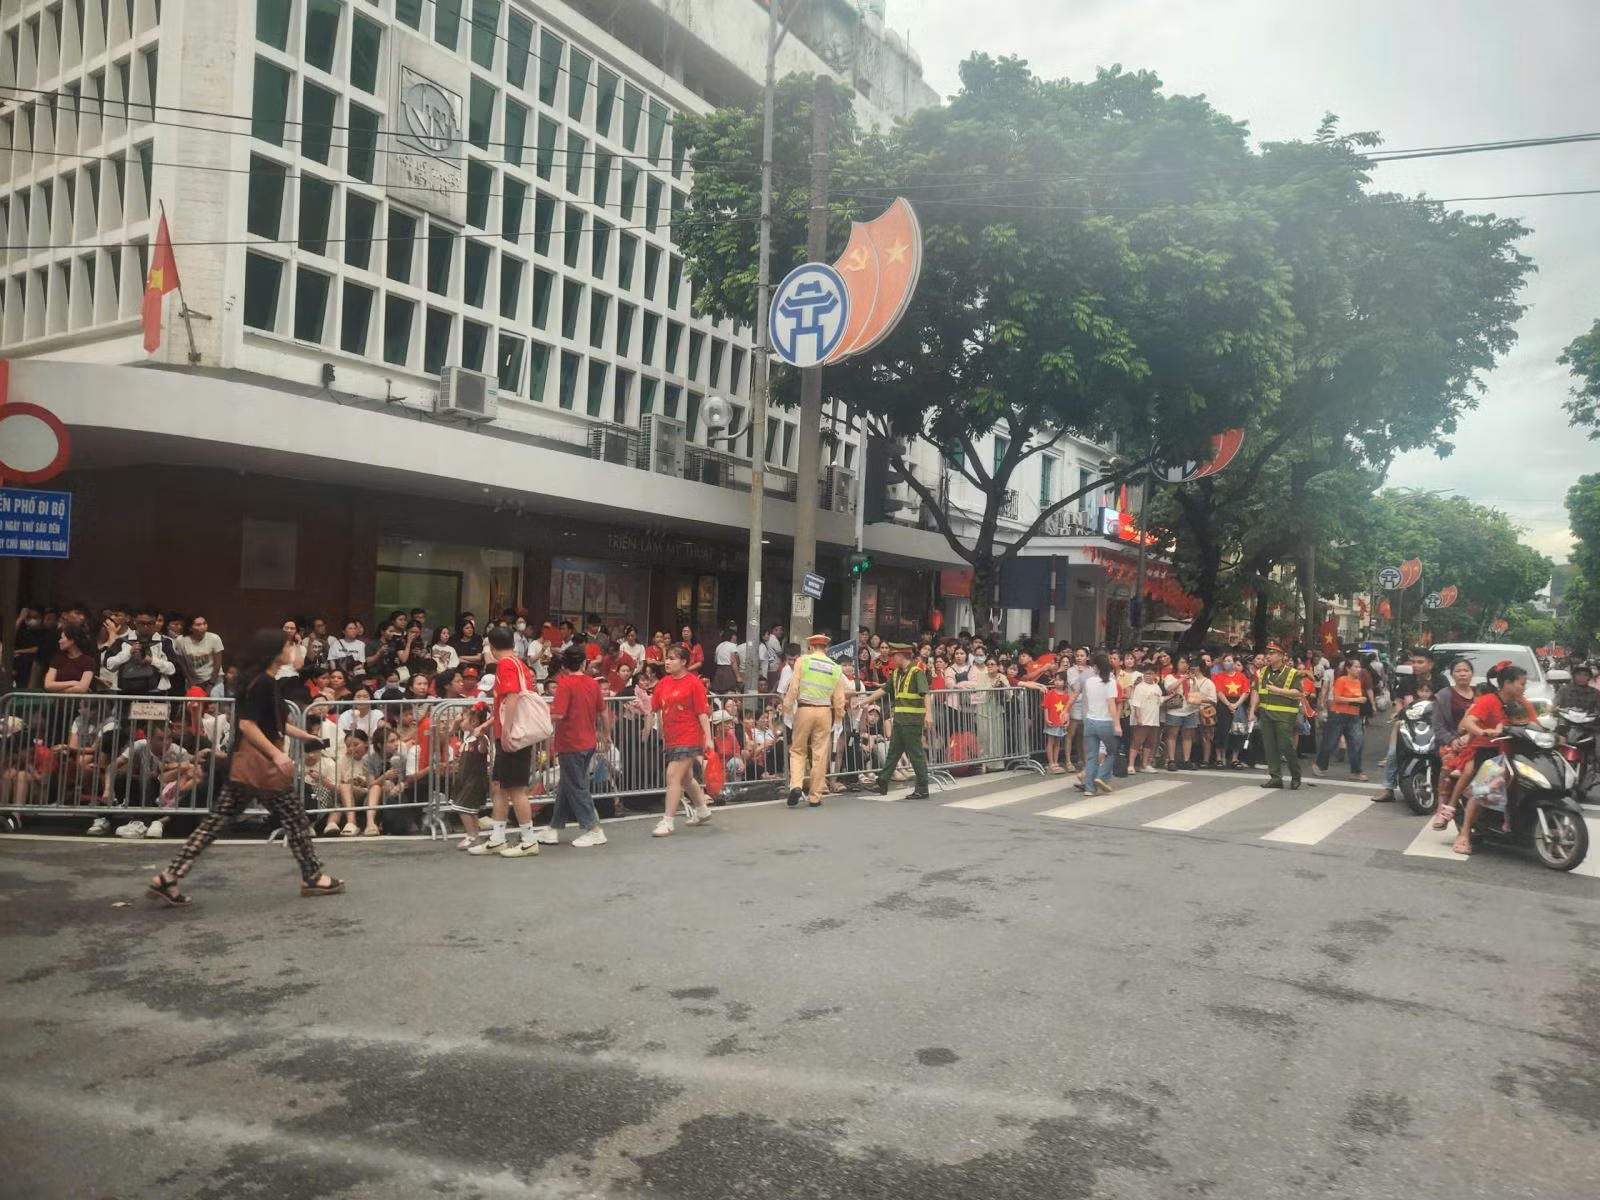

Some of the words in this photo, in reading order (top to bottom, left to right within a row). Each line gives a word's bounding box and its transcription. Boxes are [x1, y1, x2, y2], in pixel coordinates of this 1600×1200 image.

[14, 496, 38, 514] PHỐ
[38, 500, 49, 515] ĐI
[51, 499, 65, 520] BỘ
